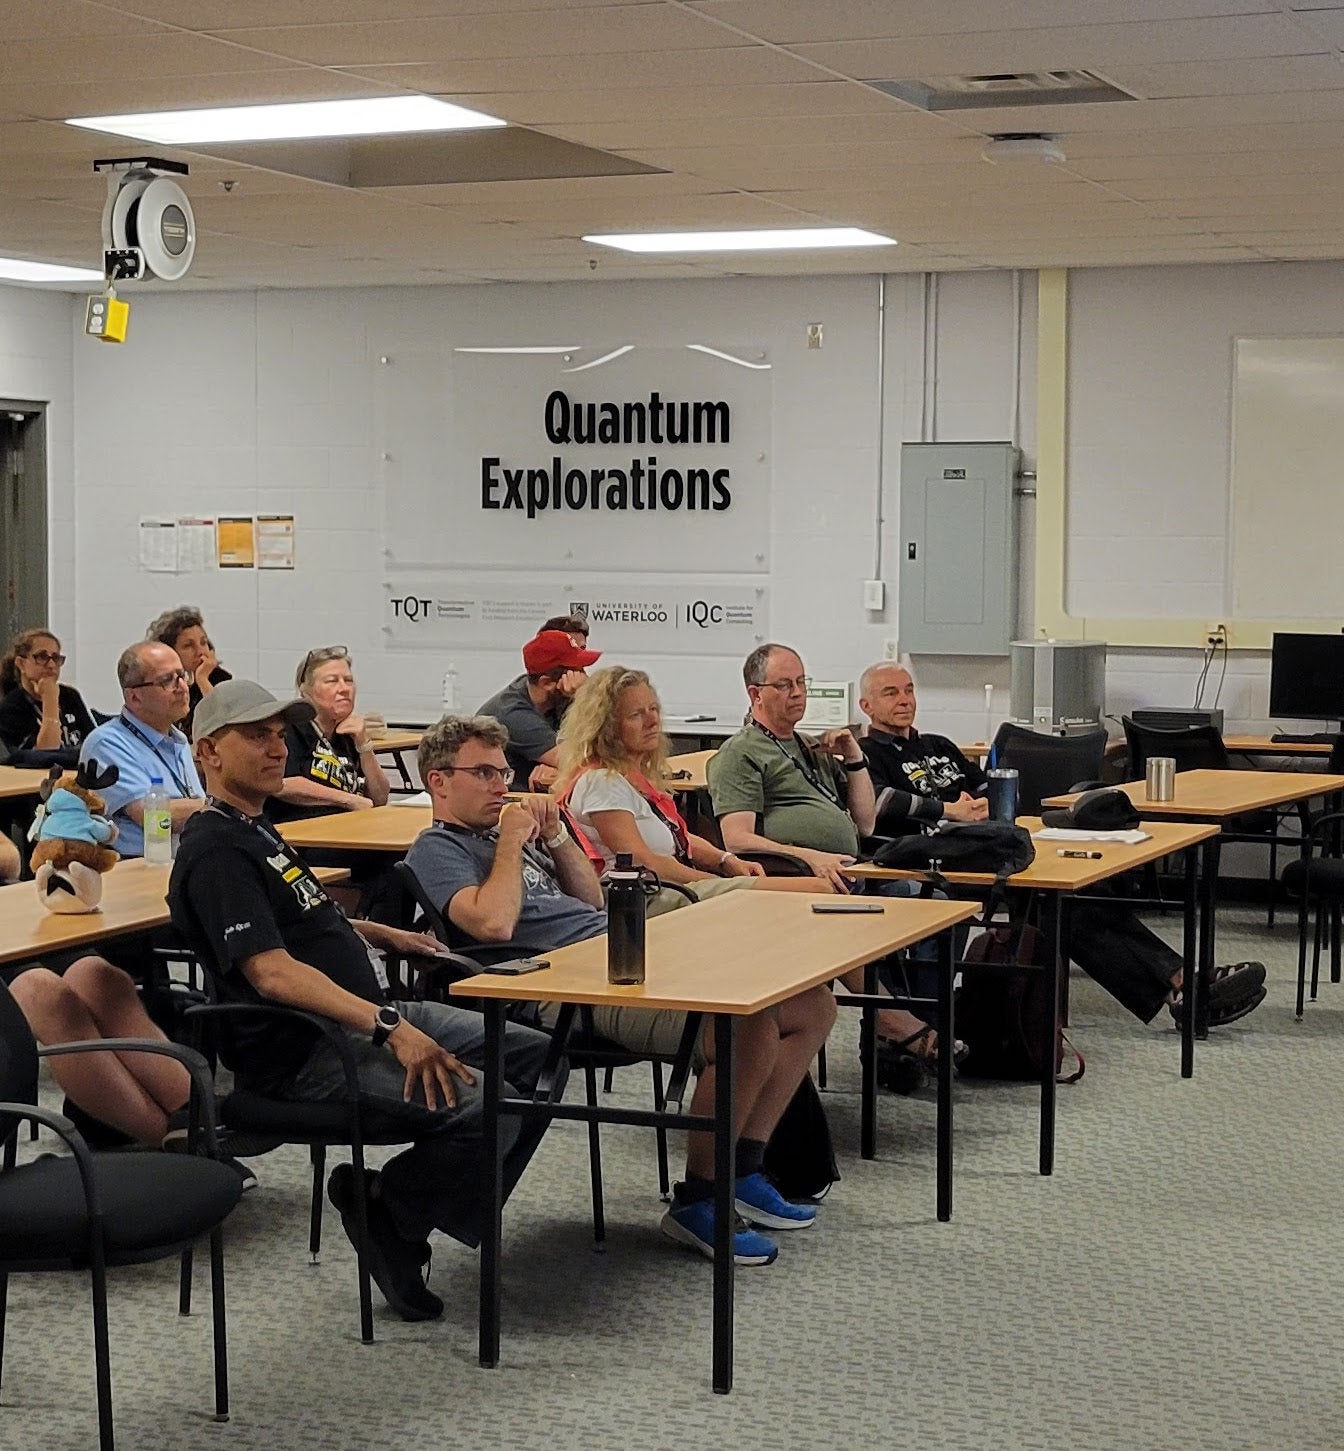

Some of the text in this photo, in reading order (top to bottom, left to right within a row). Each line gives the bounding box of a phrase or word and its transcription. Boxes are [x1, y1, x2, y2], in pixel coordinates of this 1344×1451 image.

[545, 390, 730, 444] Quantum
[481, 457, 731, 518] Explorations
[391, 596, 432, 622] TQT
[592, 610, 668, 622] WATERLOO
[687, 601, 723, 628] IQC
